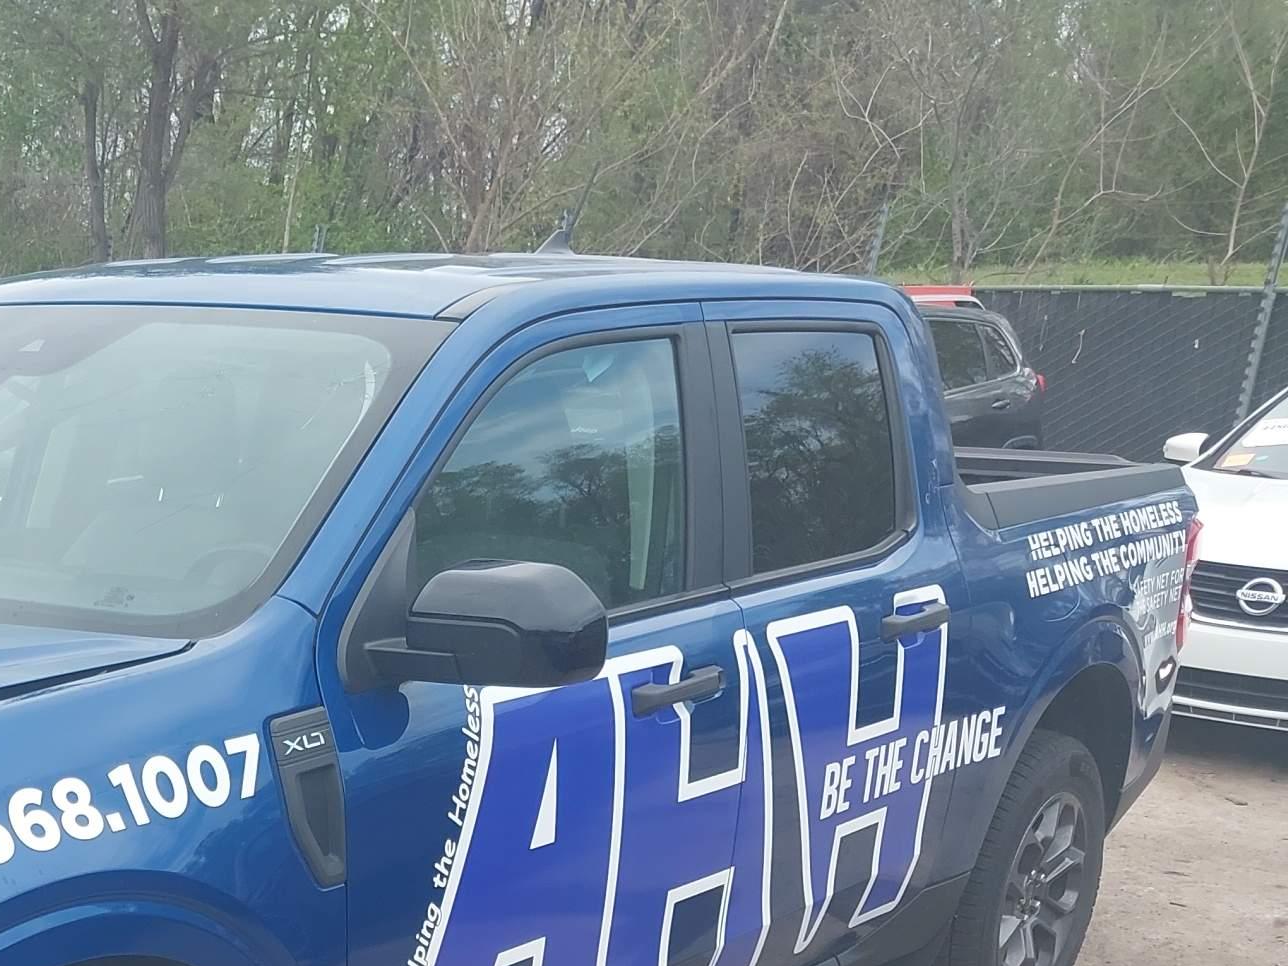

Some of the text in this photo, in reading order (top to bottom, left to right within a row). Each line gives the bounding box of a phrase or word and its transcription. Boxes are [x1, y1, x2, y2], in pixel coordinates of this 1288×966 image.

[1027, 501, 1183, 561] HELPING THE HOMELESS
[1026, 529, 1186, 599] HELPING THE COMMUNITY
[1156, 572, 1170, 590] NET
[1241, 591, 1280, 602] NISSAN
[282, 732, 325, 756] XLT
[819, 705, 1006, 821] BE THE CHANGE
[433, 839, 457, 889] the
[447, 685, 482, 827] Homeless
